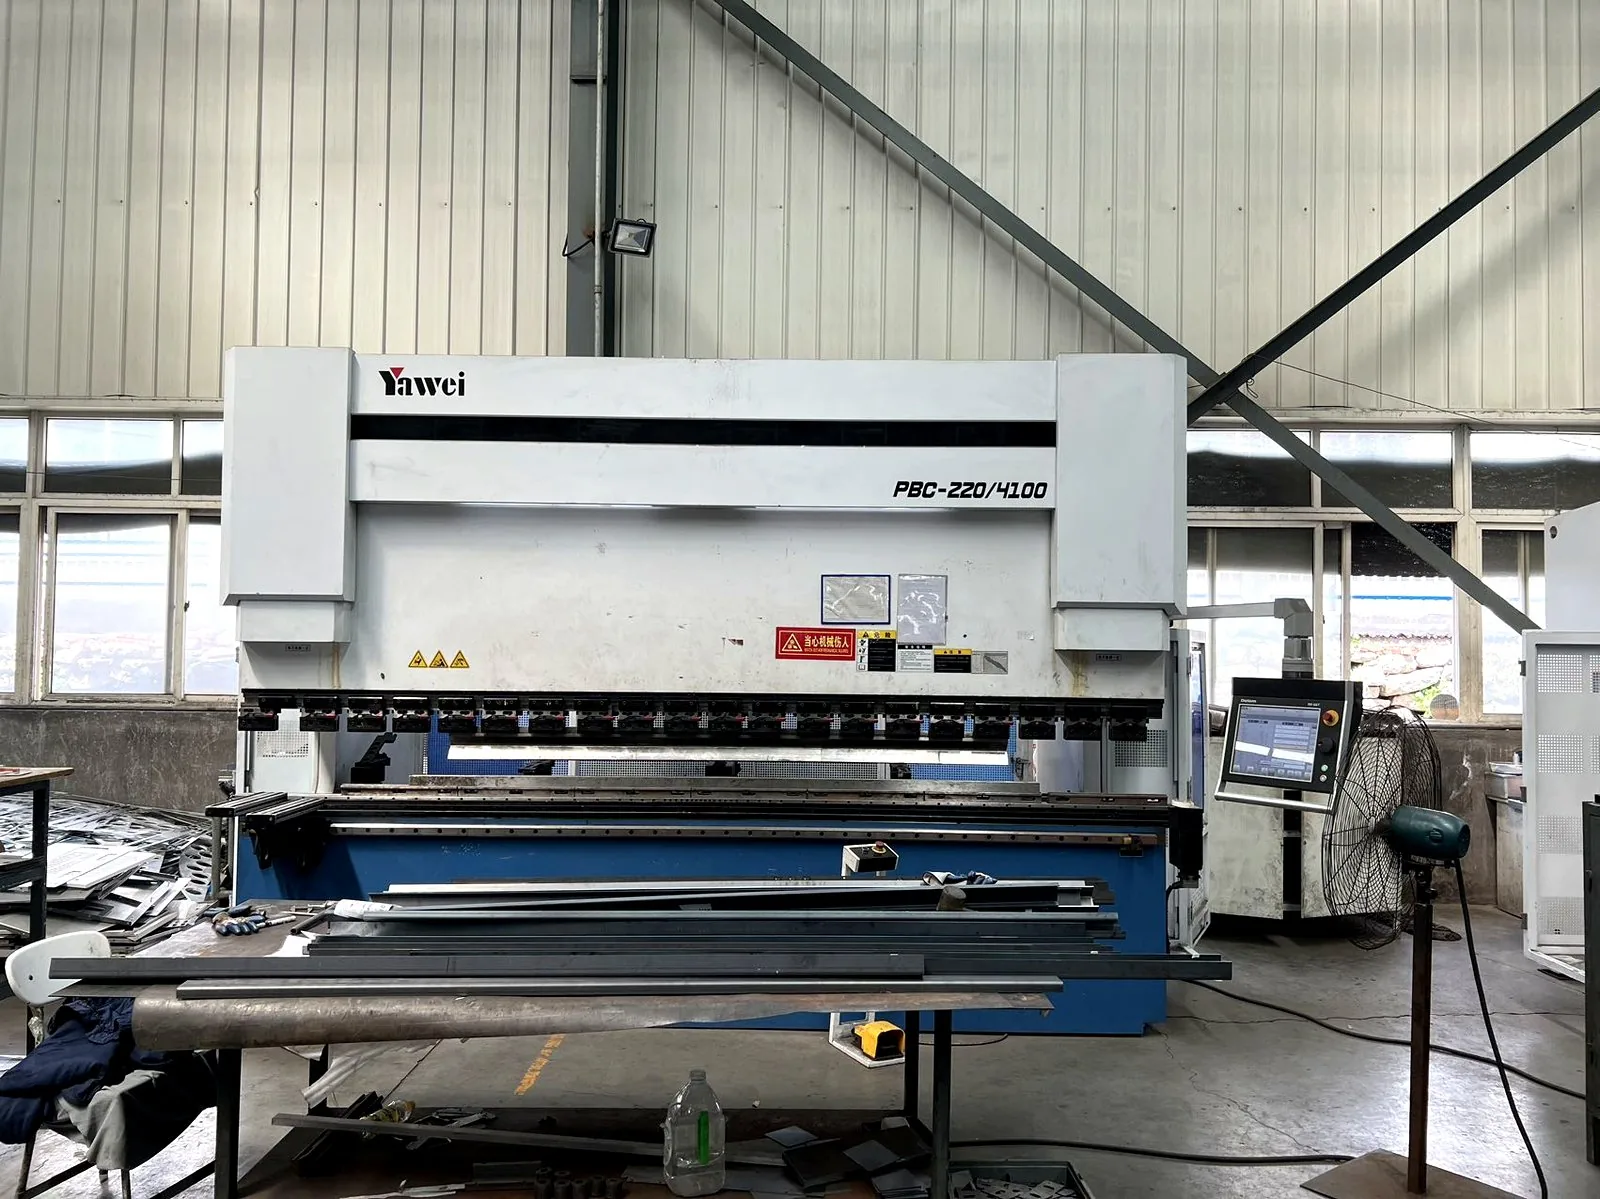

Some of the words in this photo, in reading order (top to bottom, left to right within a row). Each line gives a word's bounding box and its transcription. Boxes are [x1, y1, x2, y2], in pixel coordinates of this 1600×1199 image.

[378, 367, 465, 396] Yawei
[893, 481, 1048, 499] PBC-220/4100
[804, 635, 849, 649] 当心机械伤人
